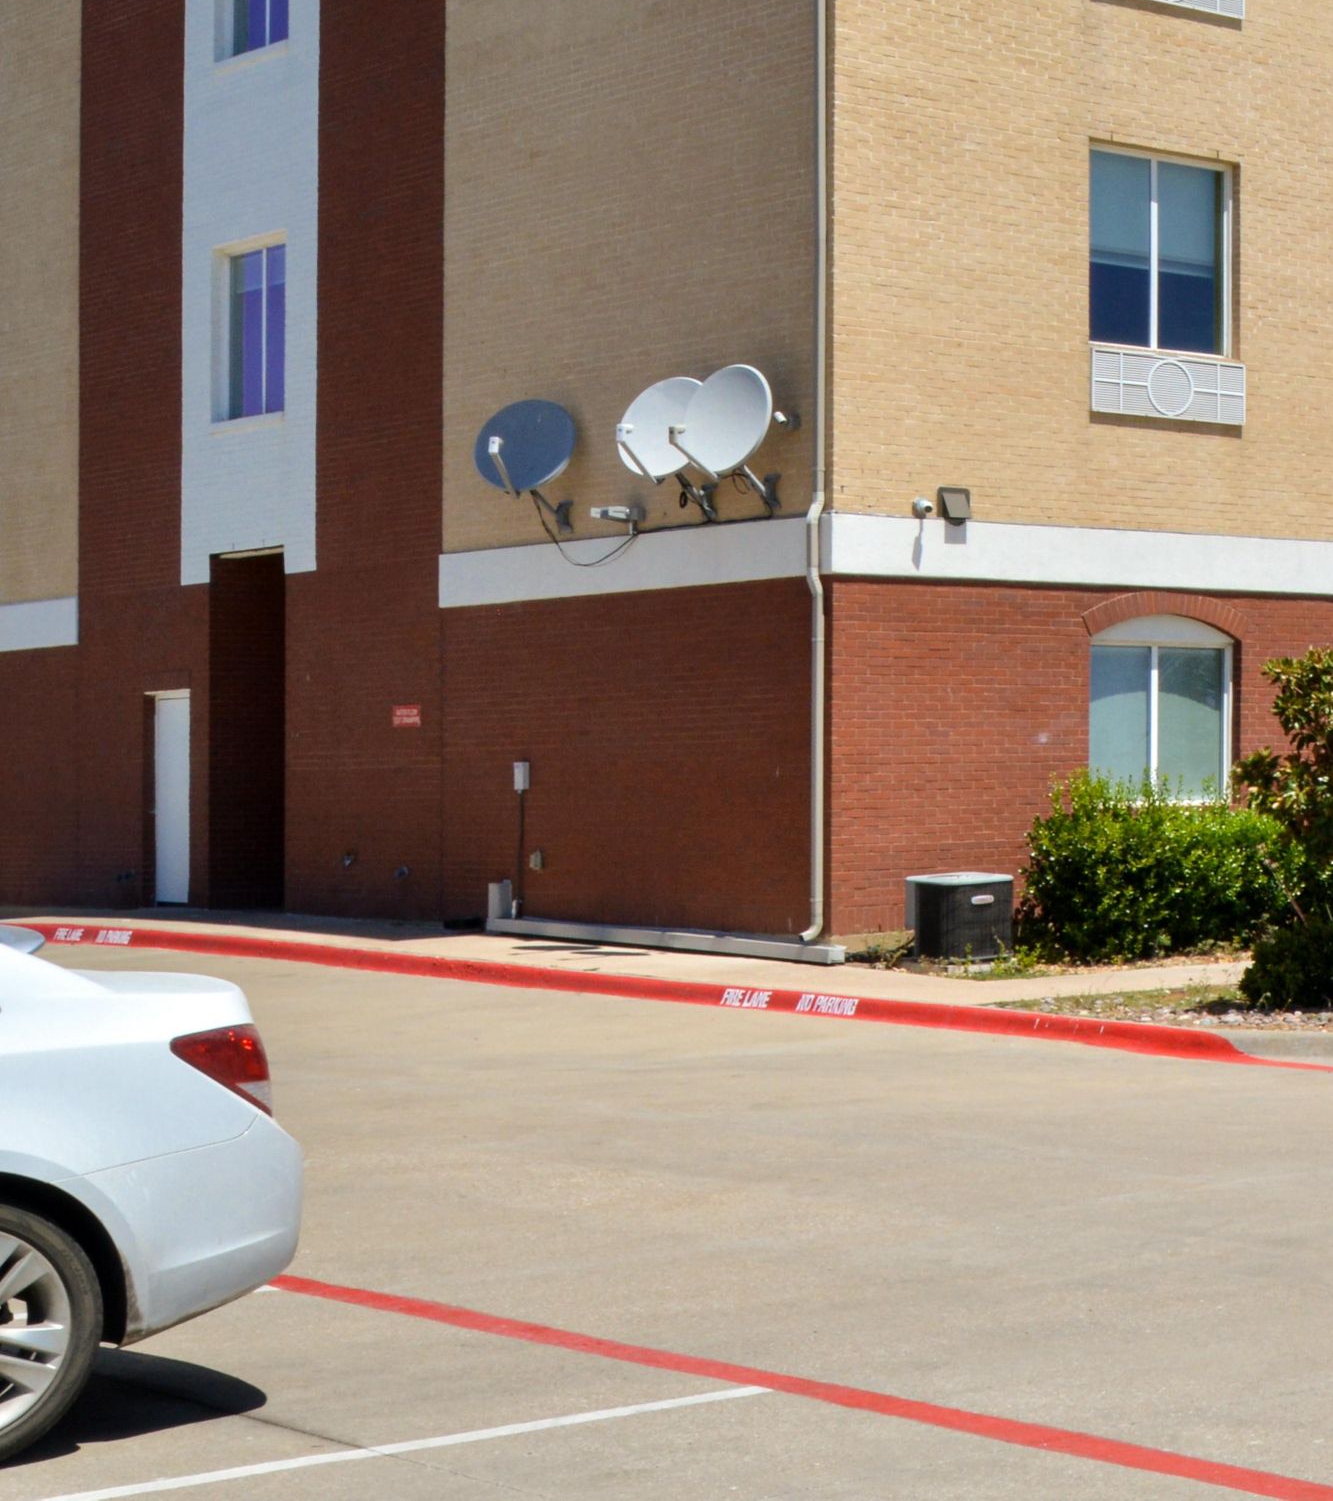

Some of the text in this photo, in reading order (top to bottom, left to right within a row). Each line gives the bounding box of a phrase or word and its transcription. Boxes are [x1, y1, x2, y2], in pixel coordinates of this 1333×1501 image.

[720, 988, 772, 1008] FIRE LANE
[795, 993, 859, 1016] NO PARKING
